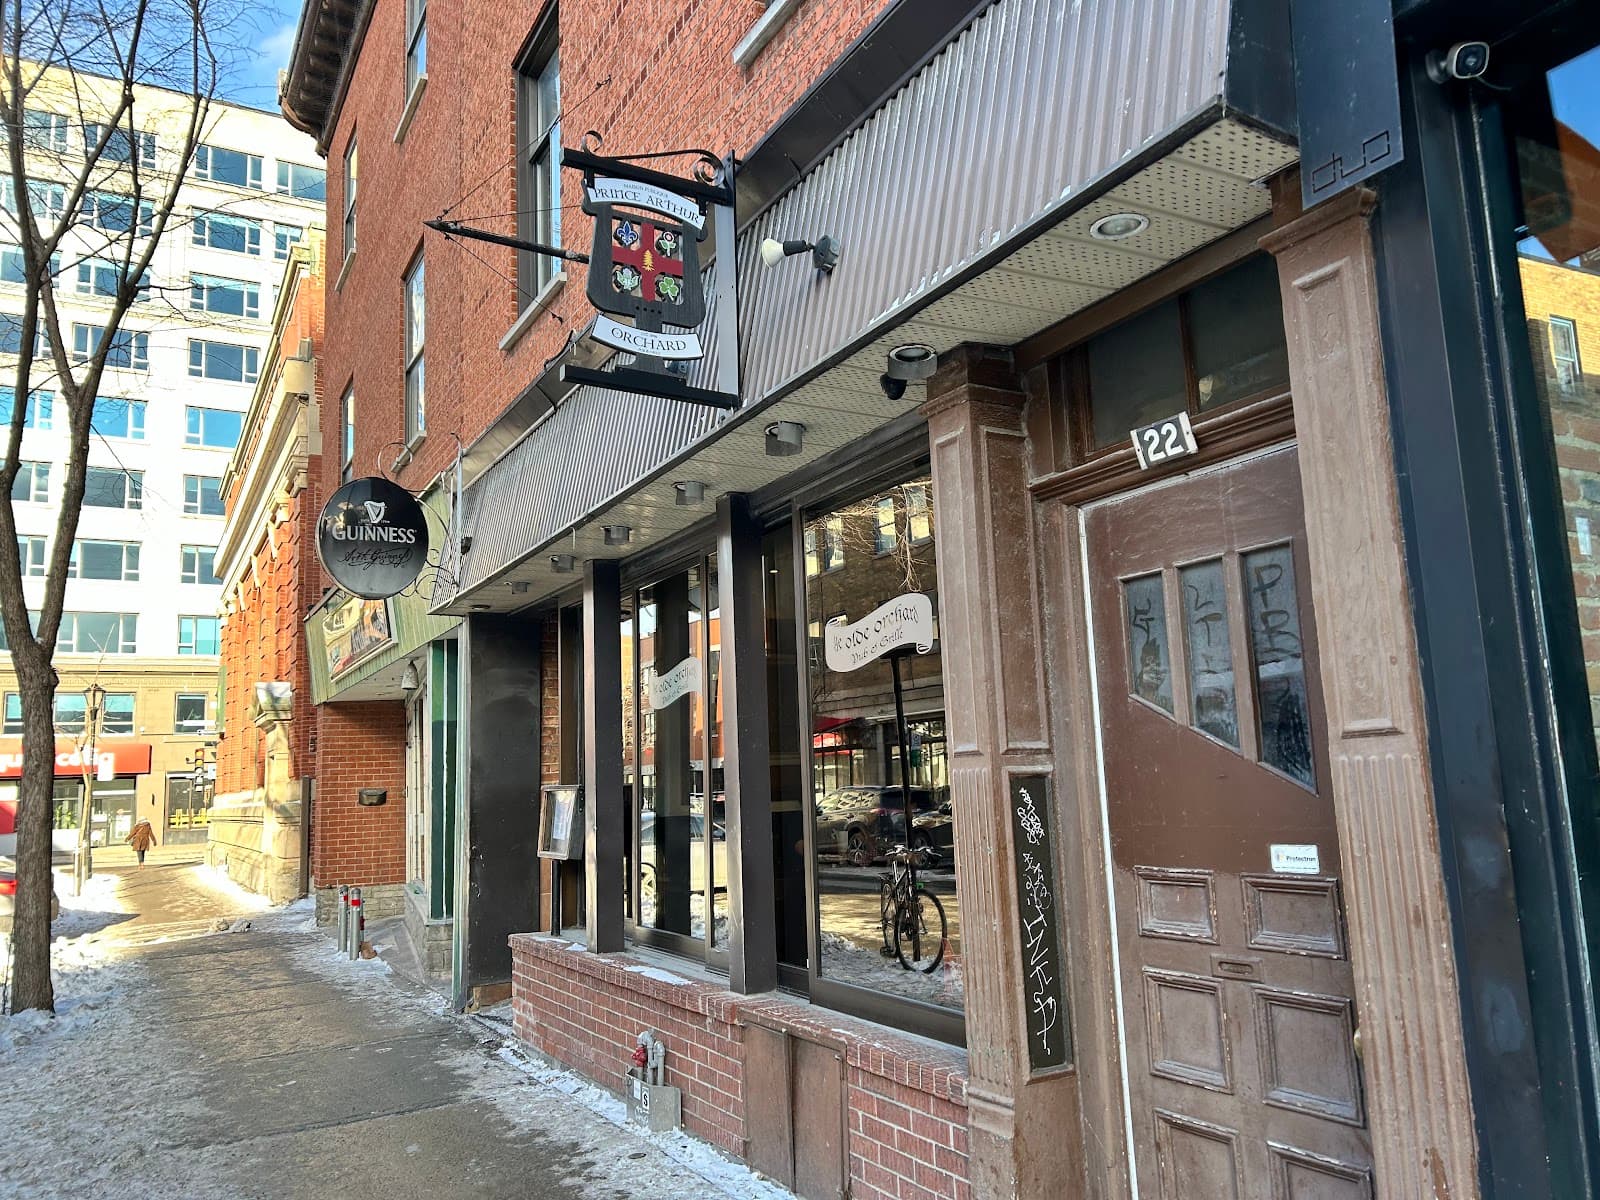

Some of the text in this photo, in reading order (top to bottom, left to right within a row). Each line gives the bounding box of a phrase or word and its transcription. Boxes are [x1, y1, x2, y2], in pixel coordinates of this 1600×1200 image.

[594, 187, 699, 223] PRINCE ARTHUR
[611, 327, 687, 351] ORCHARD
[1143, 422, 1185, 462] 22
[331, 524, 416, 544] GUINNESS
